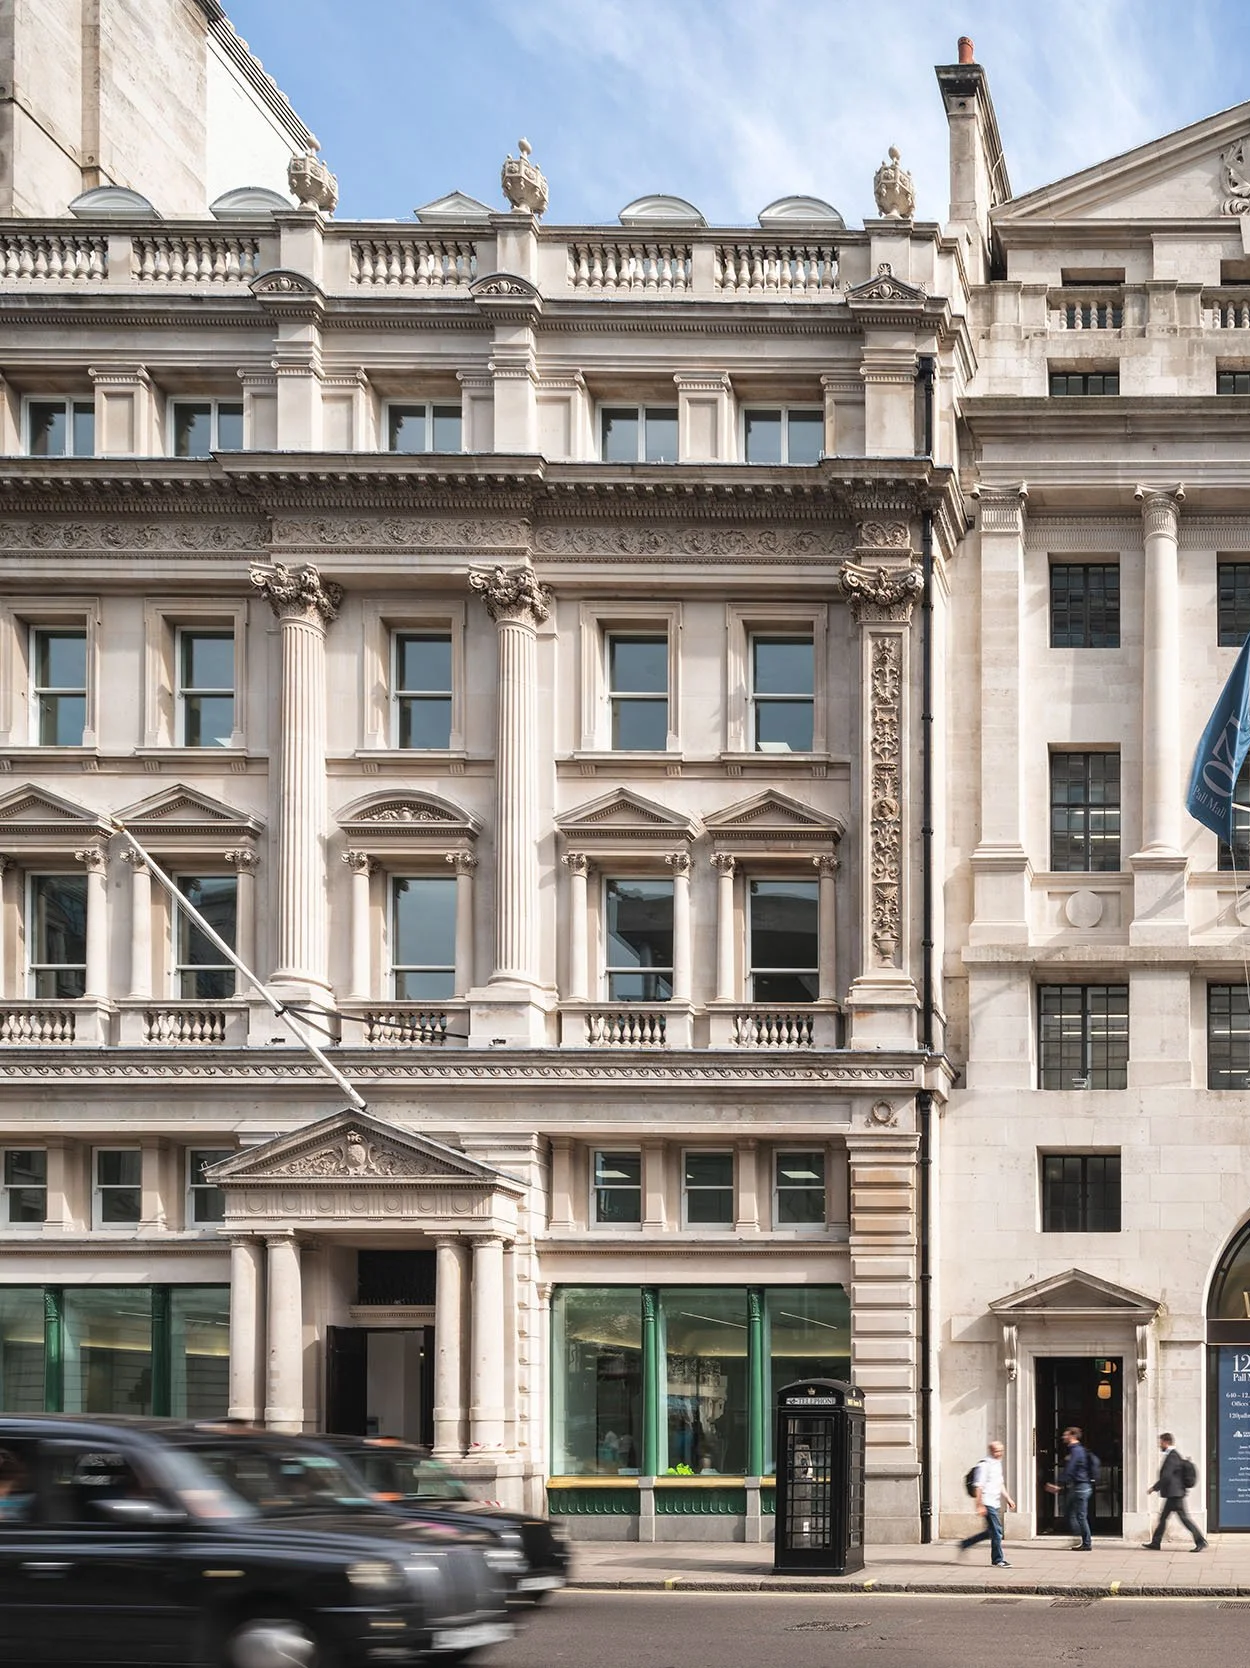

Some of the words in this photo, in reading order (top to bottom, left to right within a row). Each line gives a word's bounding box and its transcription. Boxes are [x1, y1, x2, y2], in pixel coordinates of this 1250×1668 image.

[1192, 785, 1208, 803] Pall
[1207, 798, 1227, 819] Mall
[1233, 1373, 1247, 1382] Pall
